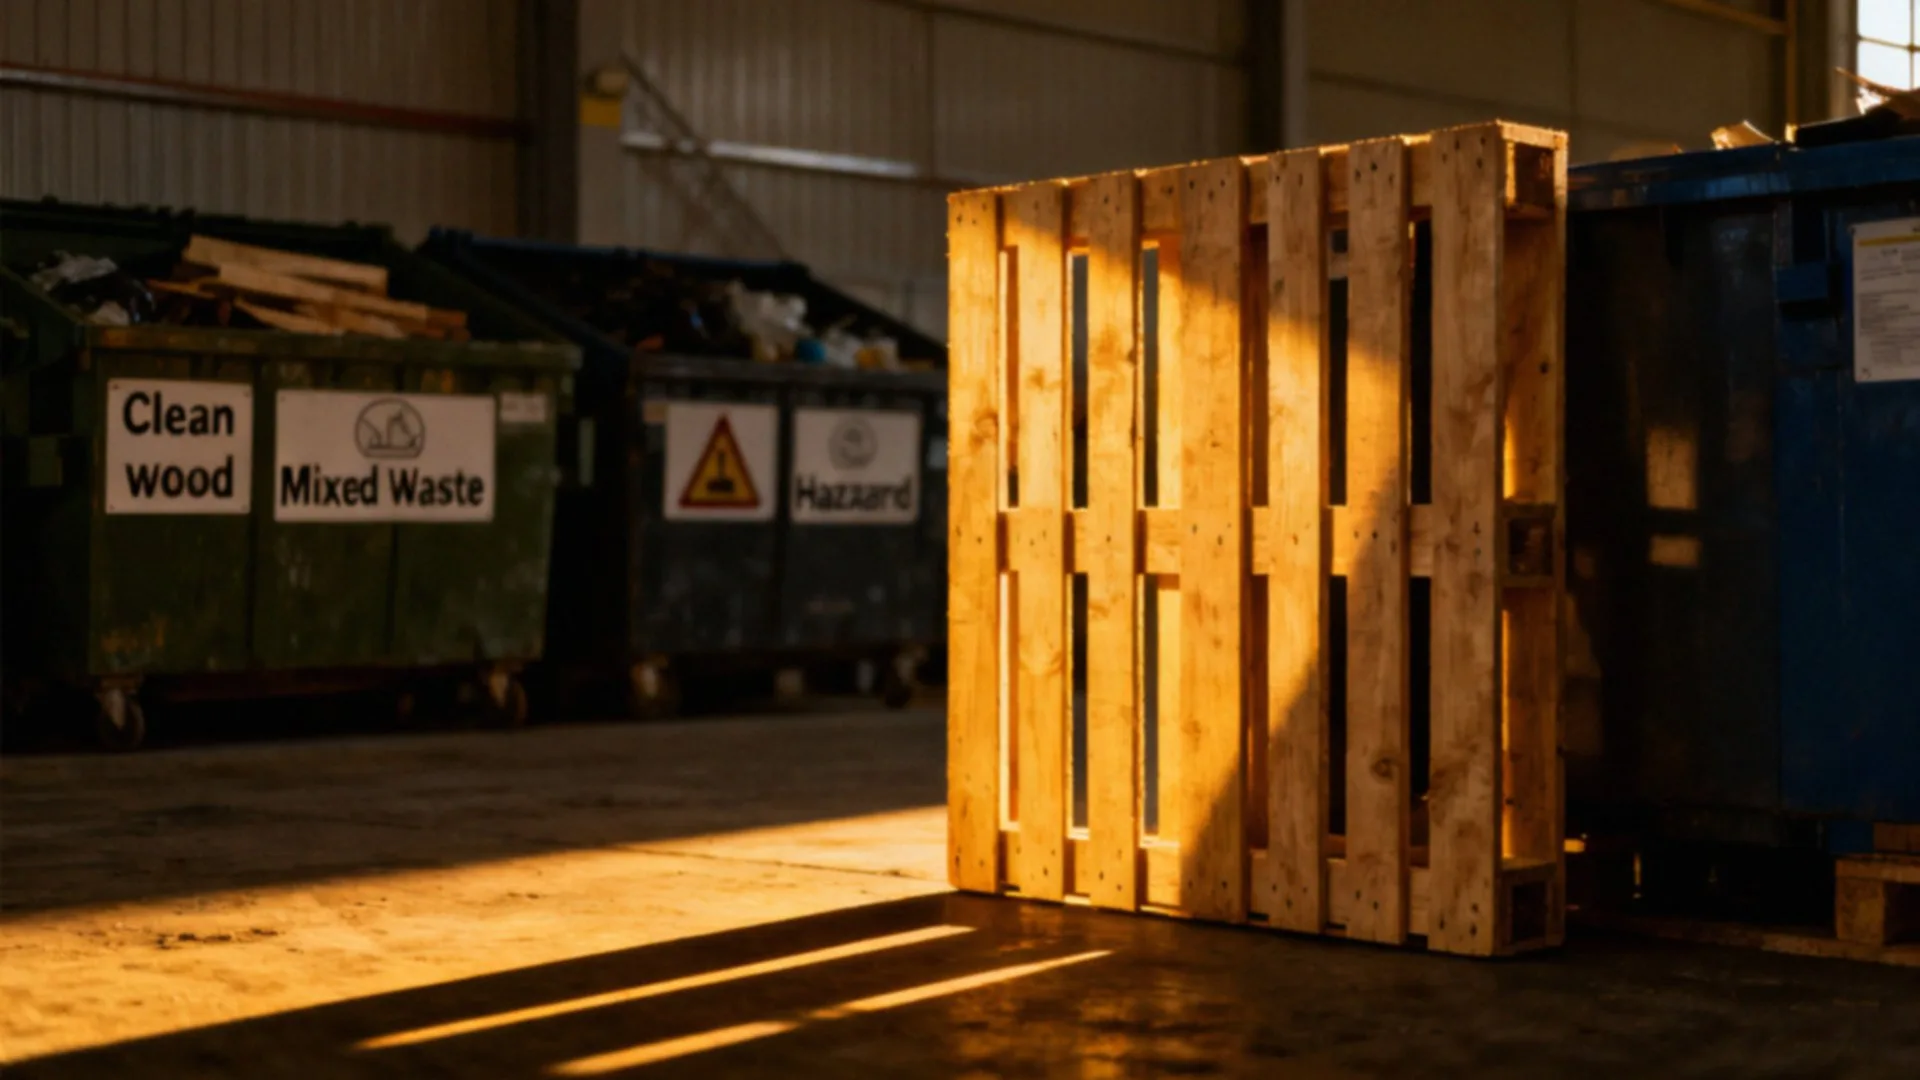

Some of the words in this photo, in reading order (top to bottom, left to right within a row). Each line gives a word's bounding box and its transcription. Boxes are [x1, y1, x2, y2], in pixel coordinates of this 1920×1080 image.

[124, 391, 234, 435] Clean
[126, 455, 234, 498] wood
[281, 465, 378, 507] Mixed
[390, 468, 484, 506] Waste
